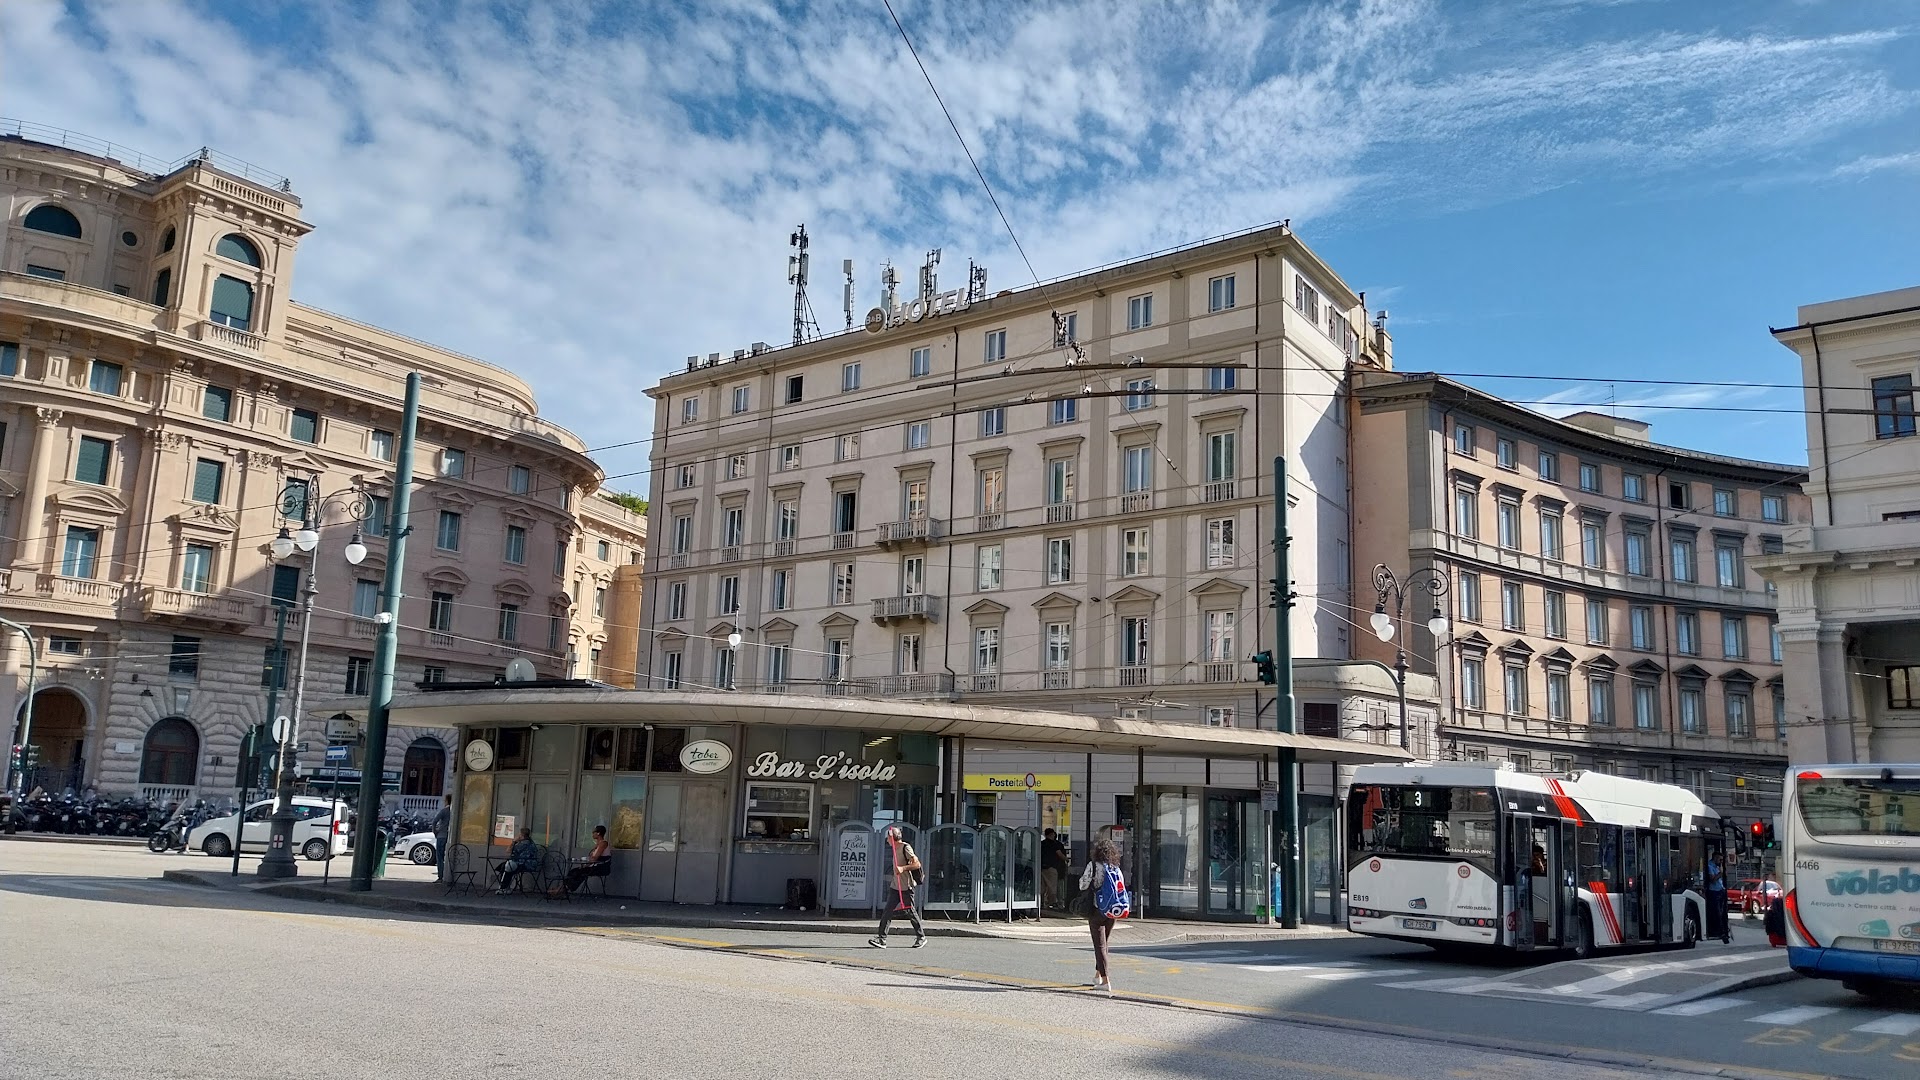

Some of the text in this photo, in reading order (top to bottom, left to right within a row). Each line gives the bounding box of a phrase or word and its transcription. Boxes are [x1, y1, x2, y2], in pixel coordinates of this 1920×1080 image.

[866, 287, 971, 328] B&B HOTEL
[690, 747, 719, 759] tober
[747, 750, 897, 782] Bar L'isola
[989, 777, 1042, 787] Posteitale
[1414, 791, 1422, 807] 3
[841, 851, 866, 861] BAR
[1796, 861, 1820, 871] 4466
[1825, 867, 1920, 896] volab
[1353, 894, 1369, 902] E819
[1810, 900, 1845, 909] Aeroporto
[1854, 902, 1878, 910] Centro
[1880, 903, 1897, 911] città
